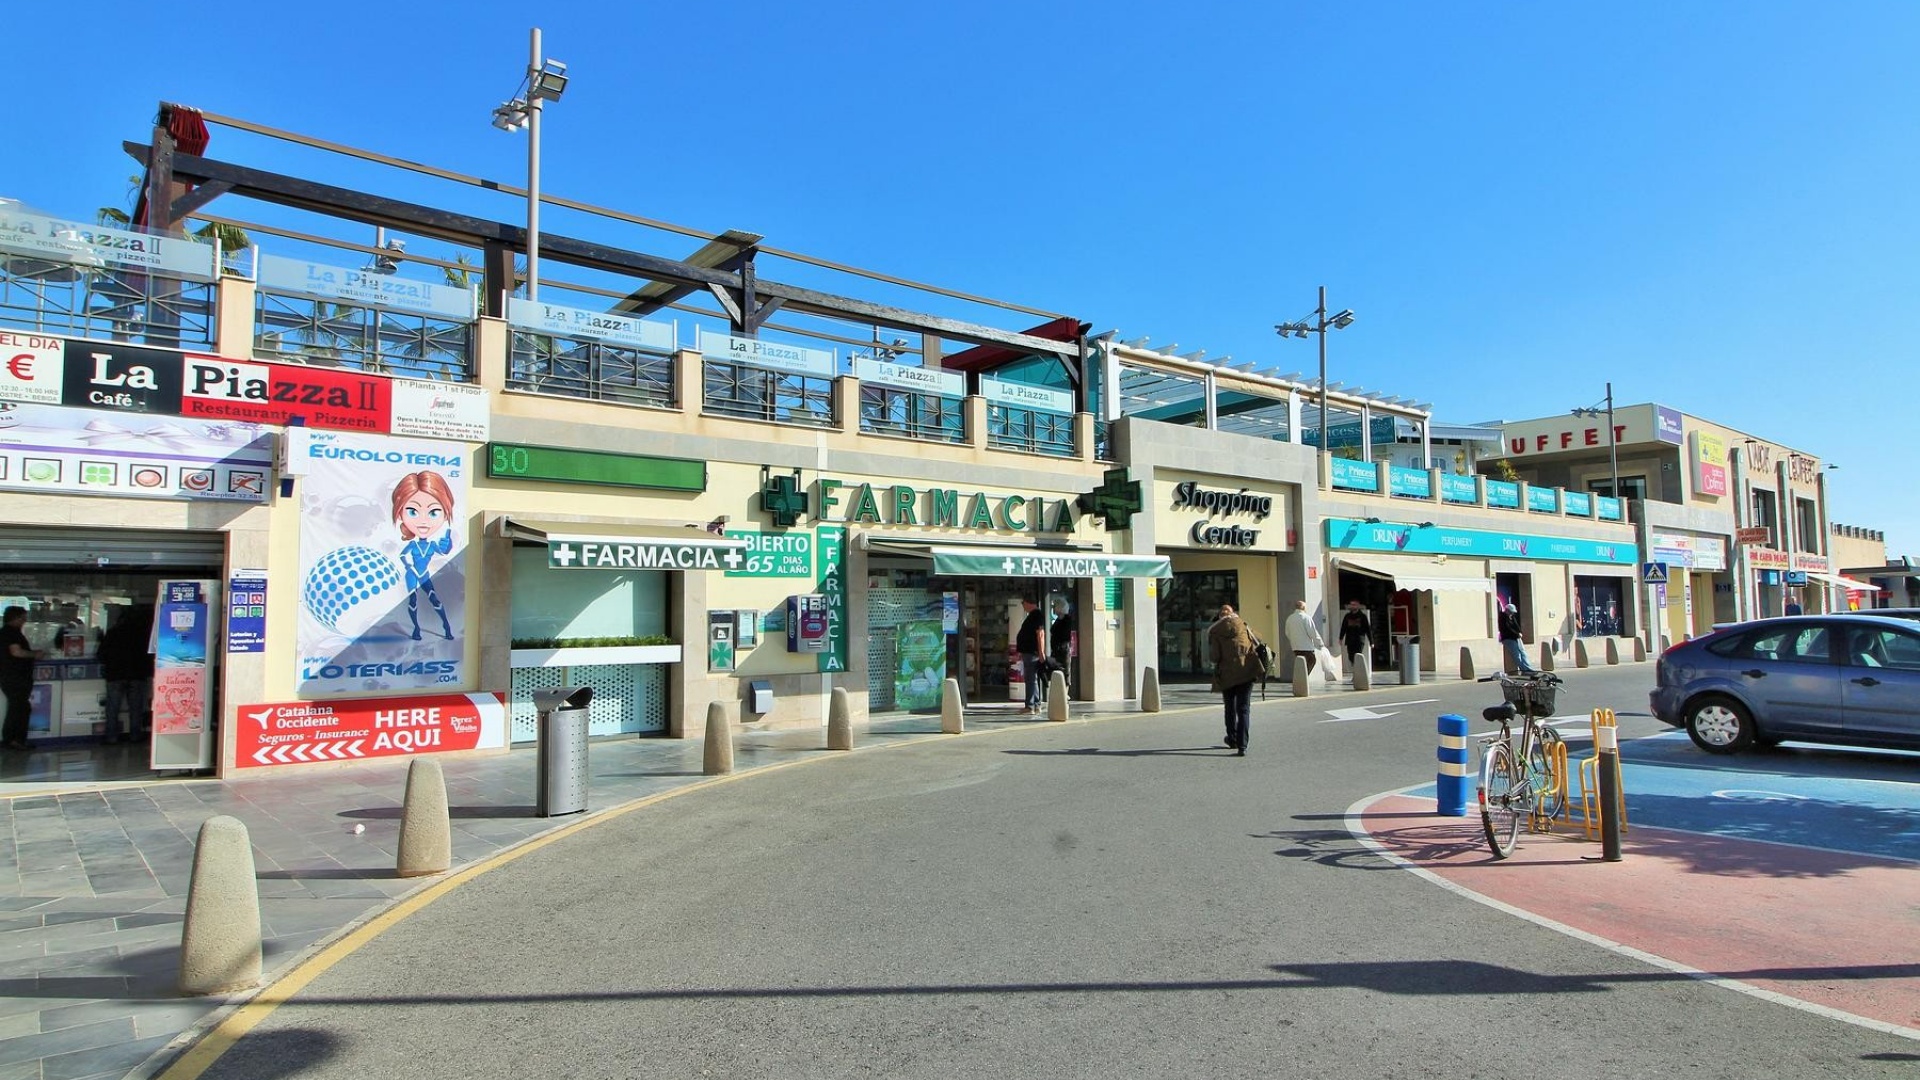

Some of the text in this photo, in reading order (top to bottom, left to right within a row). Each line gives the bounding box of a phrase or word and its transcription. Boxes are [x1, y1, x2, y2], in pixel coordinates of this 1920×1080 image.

[0, 213, 35, 235] La
[50, 221, 145, 253] Piazza
[117, 252, 161, 264] pizzeria
[307, 265, 335, 283] La
[345, 270, 419, 297] Piazza
[544, 306, 567, 322] La
[574, 311, 632, 332] Piazza
[730, 338, 746, 352] La
[752, 342, 799, 360] Piazza
[90, 353, 158, 390] La
[192, 364, 351, 408] Piazza
[878, 364, 894, 376] La
[898, 366, 936, 382] Piazza
[410, 382, 436, 391] Planta
[460, 387, 482, 396] Floor
[1001, 384, 1014, 396] La
[1017, 387, 1049, 400] Piazza
[90, 390, 133, 407] Café
[314, 412, 376, 428] Pizzeria
[1504, 426, 1626, 454] UFFET
[310, 444, 460, 468] EUROLOTERIA
[493, 446, 528, 474] 30
[1747, 444, 1771, 474] WOK
[1348, 465, 1376, 478] Princess
[1404, 473, 1428, 484] Princess
[1453, 480, 1474, 490] Princess
[821, 479, 1076, 533] FARMACIA
[1174, 481, 1272, 518] Shopping
[1192, 520, 1262, 548] Center
[1442, 536, 1472, 546] PERFUMERY
[582, 544, 719, 568] FARMACIA
[728, 556, 802, 572] 65 DIAS
[790, 565, 808, 574] AÑO
[1022, 558, 1100, 576] FARMACIA
[825, 547, 841, 668] FARMACIA
[303, 660, 458, 680] LOTERIASS
[277, 706, 334, 718] Catalana
[375, 708, 441, 728] HERE
[277, 716, 340, 730] Occidente
[258, 729, 370, 744] Seguros Insurance
[372, 728, 442, 752] AQUI
